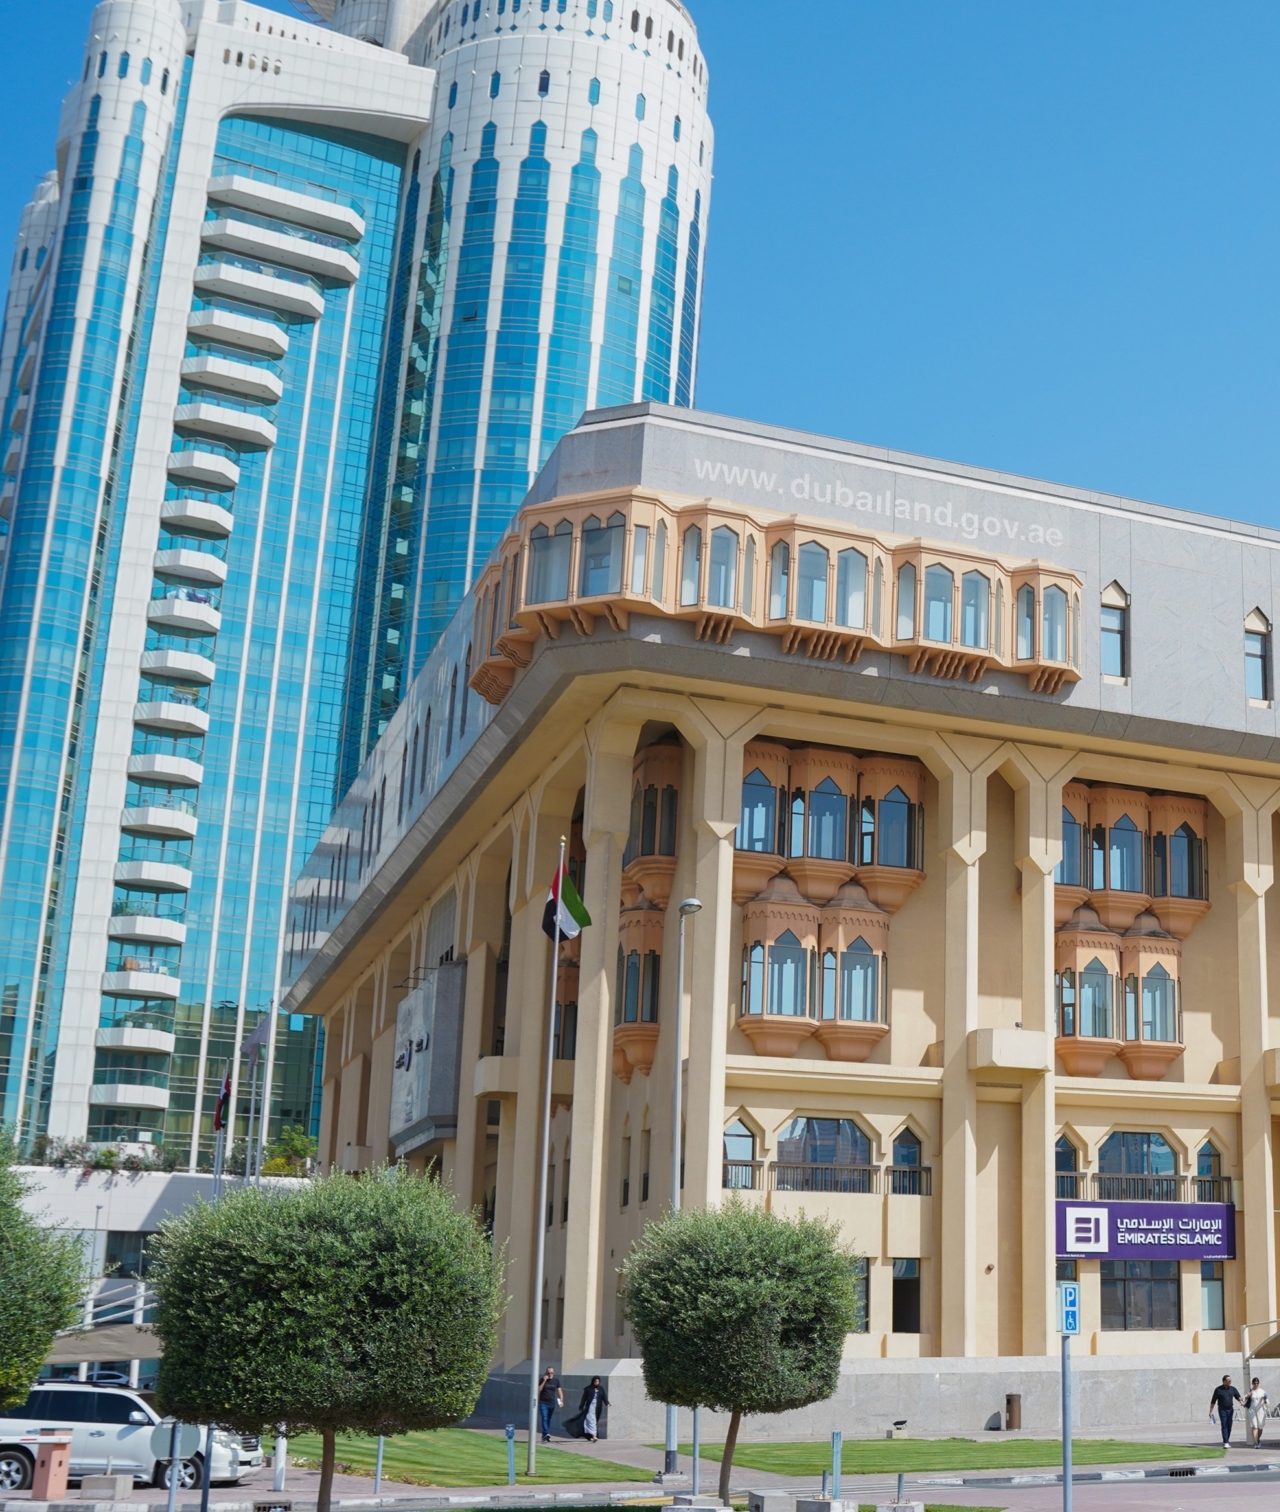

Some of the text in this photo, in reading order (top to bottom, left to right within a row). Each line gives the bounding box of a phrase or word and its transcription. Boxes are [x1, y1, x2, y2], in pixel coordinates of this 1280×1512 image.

[1117, 1218, 1222, 1232] الإمارات الإسلامي
[1117, 1233, 1222, 1245] EMIRATES ISLAMIC
[1066, 1288, 1075, 1307] P
